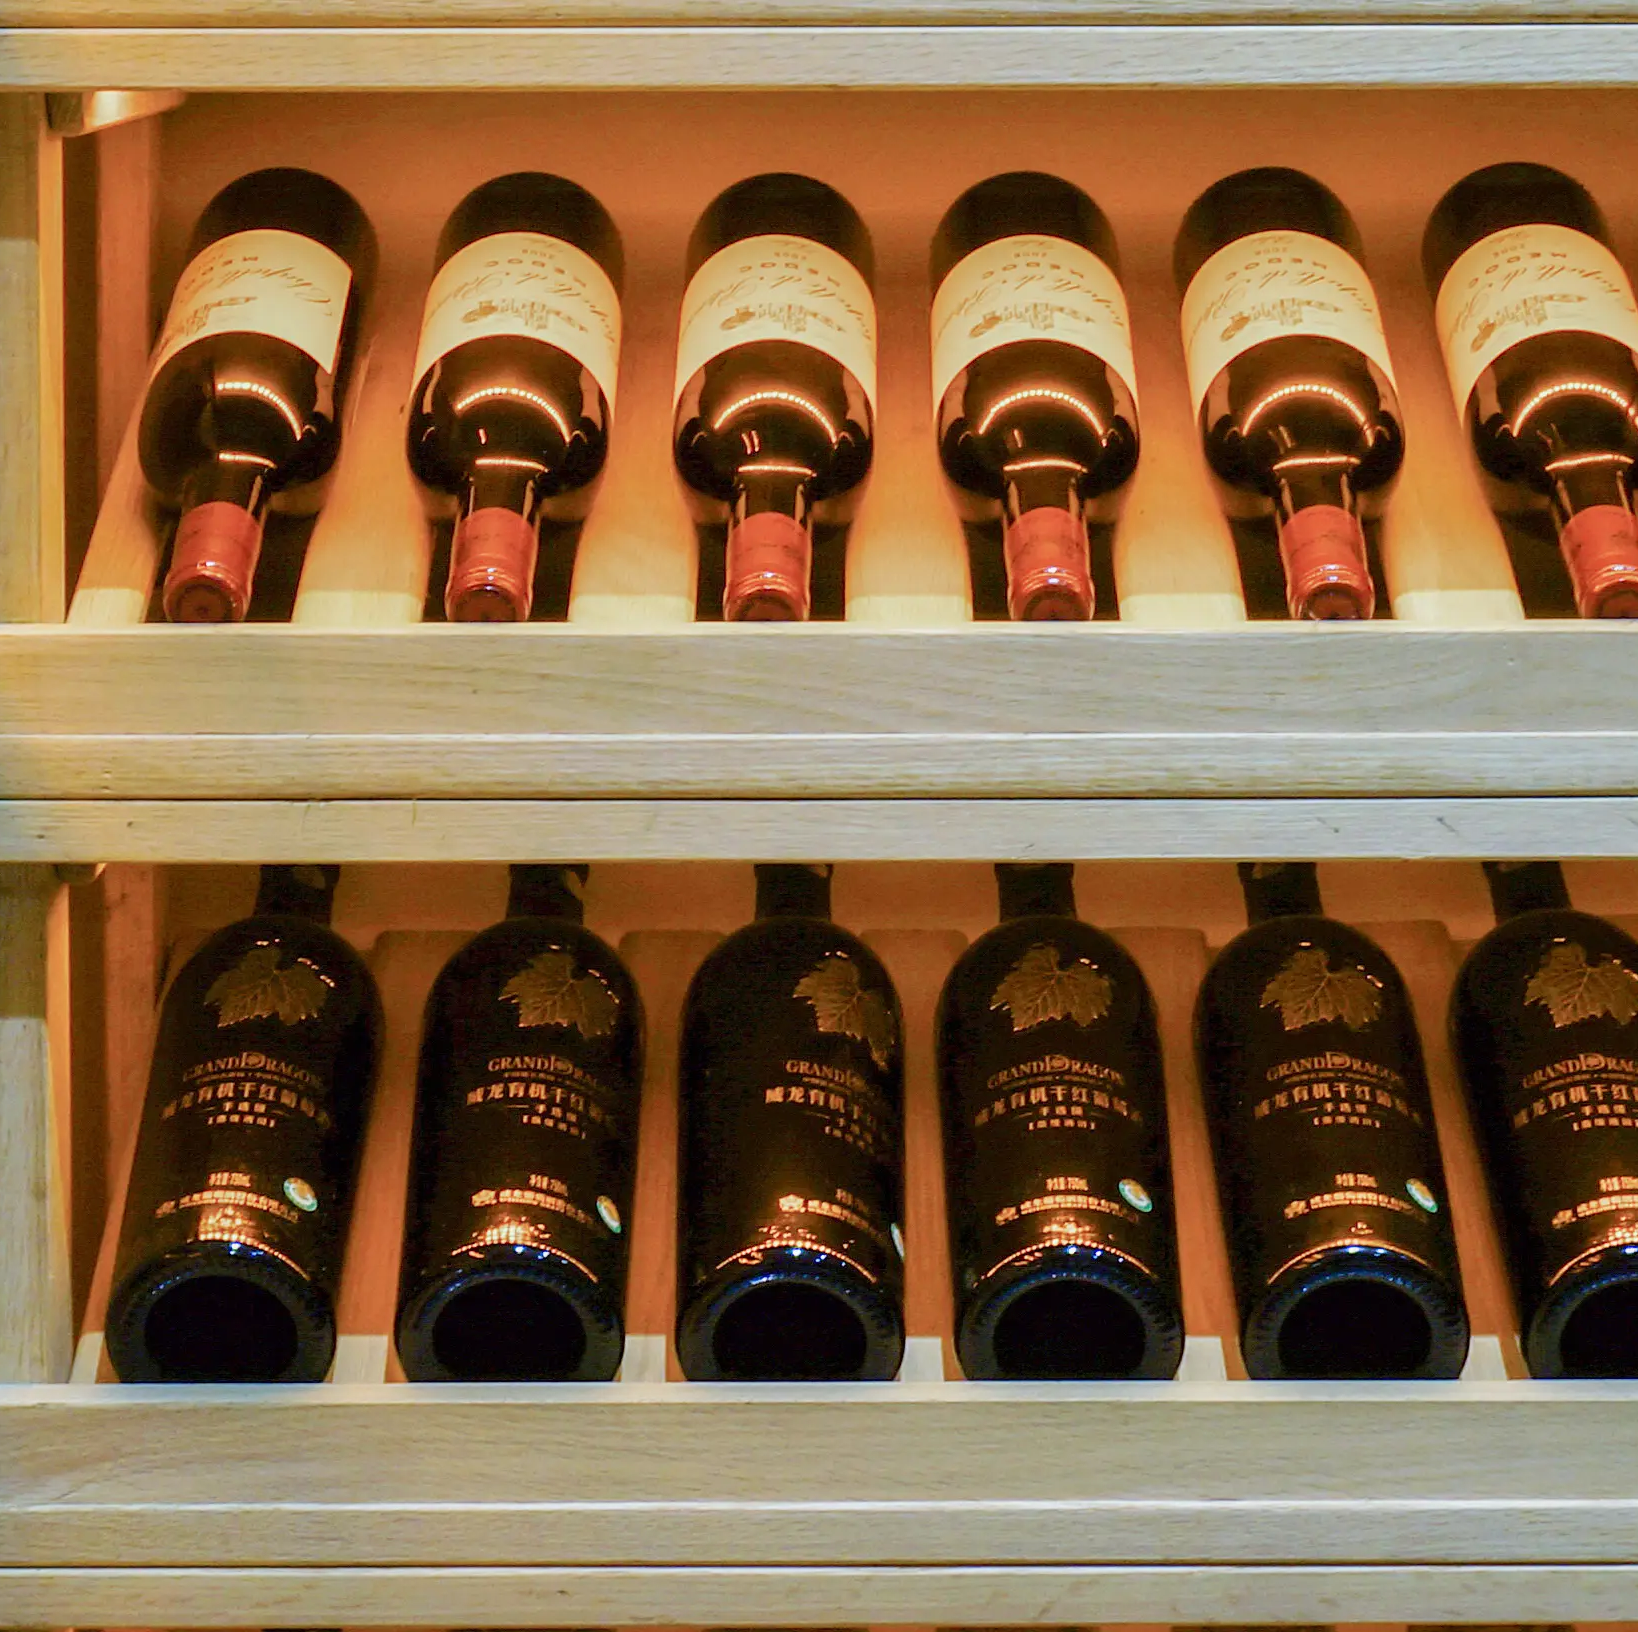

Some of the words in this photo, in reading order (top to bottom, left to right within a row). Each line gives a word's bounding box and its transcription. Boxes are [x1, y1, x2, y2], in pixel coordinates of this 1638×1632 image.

[488, 1055, 549, 1073] GRAND
[786, 1059, 847, 1083] GRAND
[987, 1058, 1045, 1089] GRAND
[1266, 1055, 1326, 1082] GRAND
